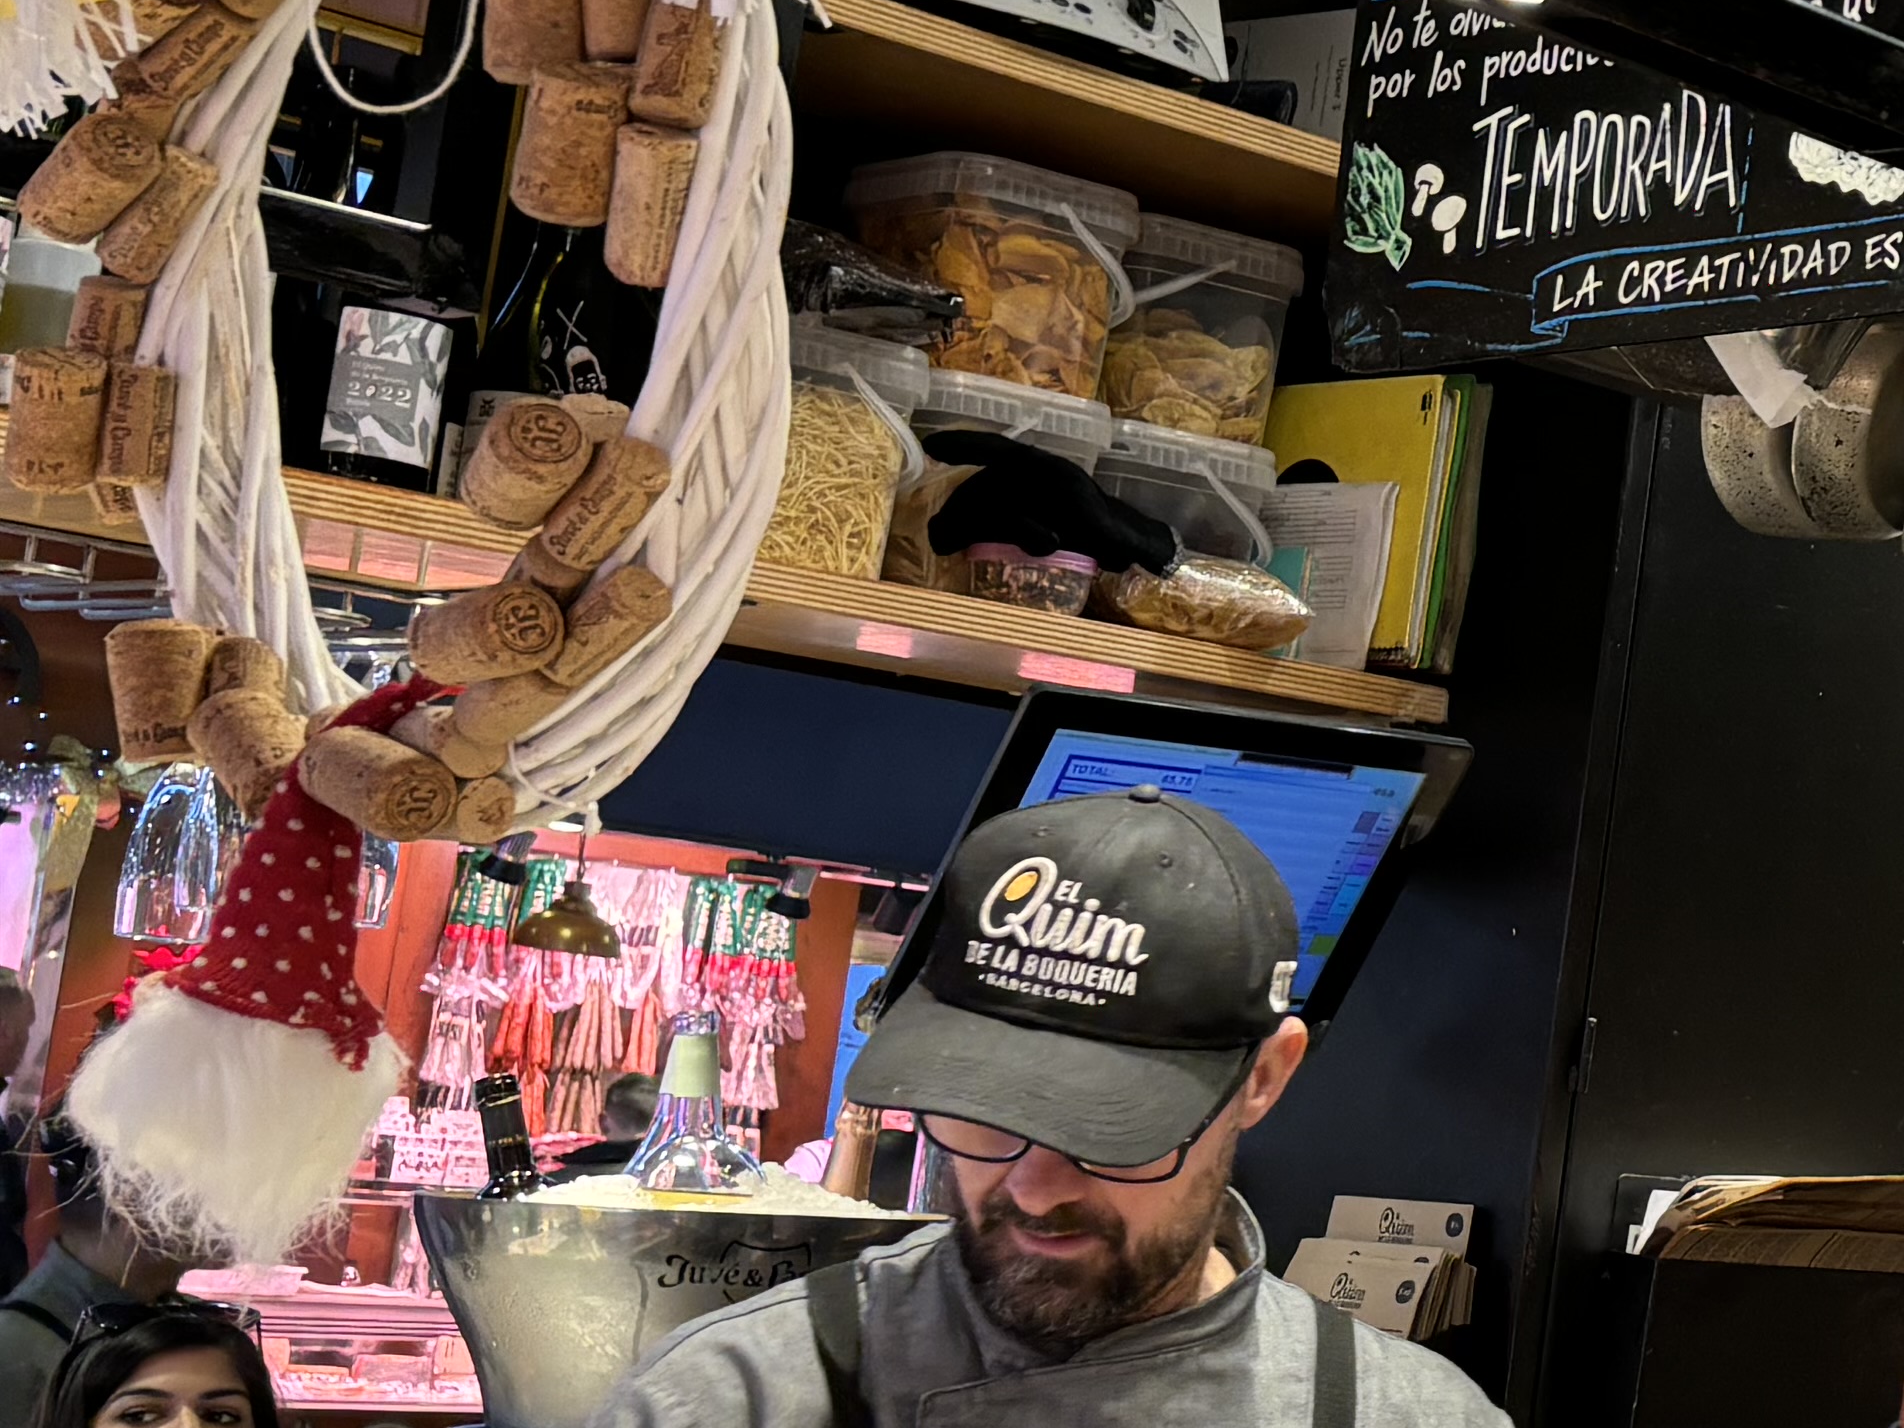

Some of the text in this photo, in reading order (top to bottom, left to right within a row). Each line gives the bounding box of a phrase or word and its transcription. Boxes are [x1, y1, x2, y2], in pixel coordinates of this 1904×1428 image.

[1360, 5, 1405, 68] No
[1366, 68, 1417, 119] por
[1427, 50, 1467, 100] los
[1472, 87, 1742, 252] TEMPORADA
[1552, 264, 1604, 313] LA
[1864, 231, 1904, 271] ES
[979, 856, 1150, 966] Quim
[1053, 879, 1084, 904] EL
[964, 940, 1138, 996] DE LA BOQUERIA
